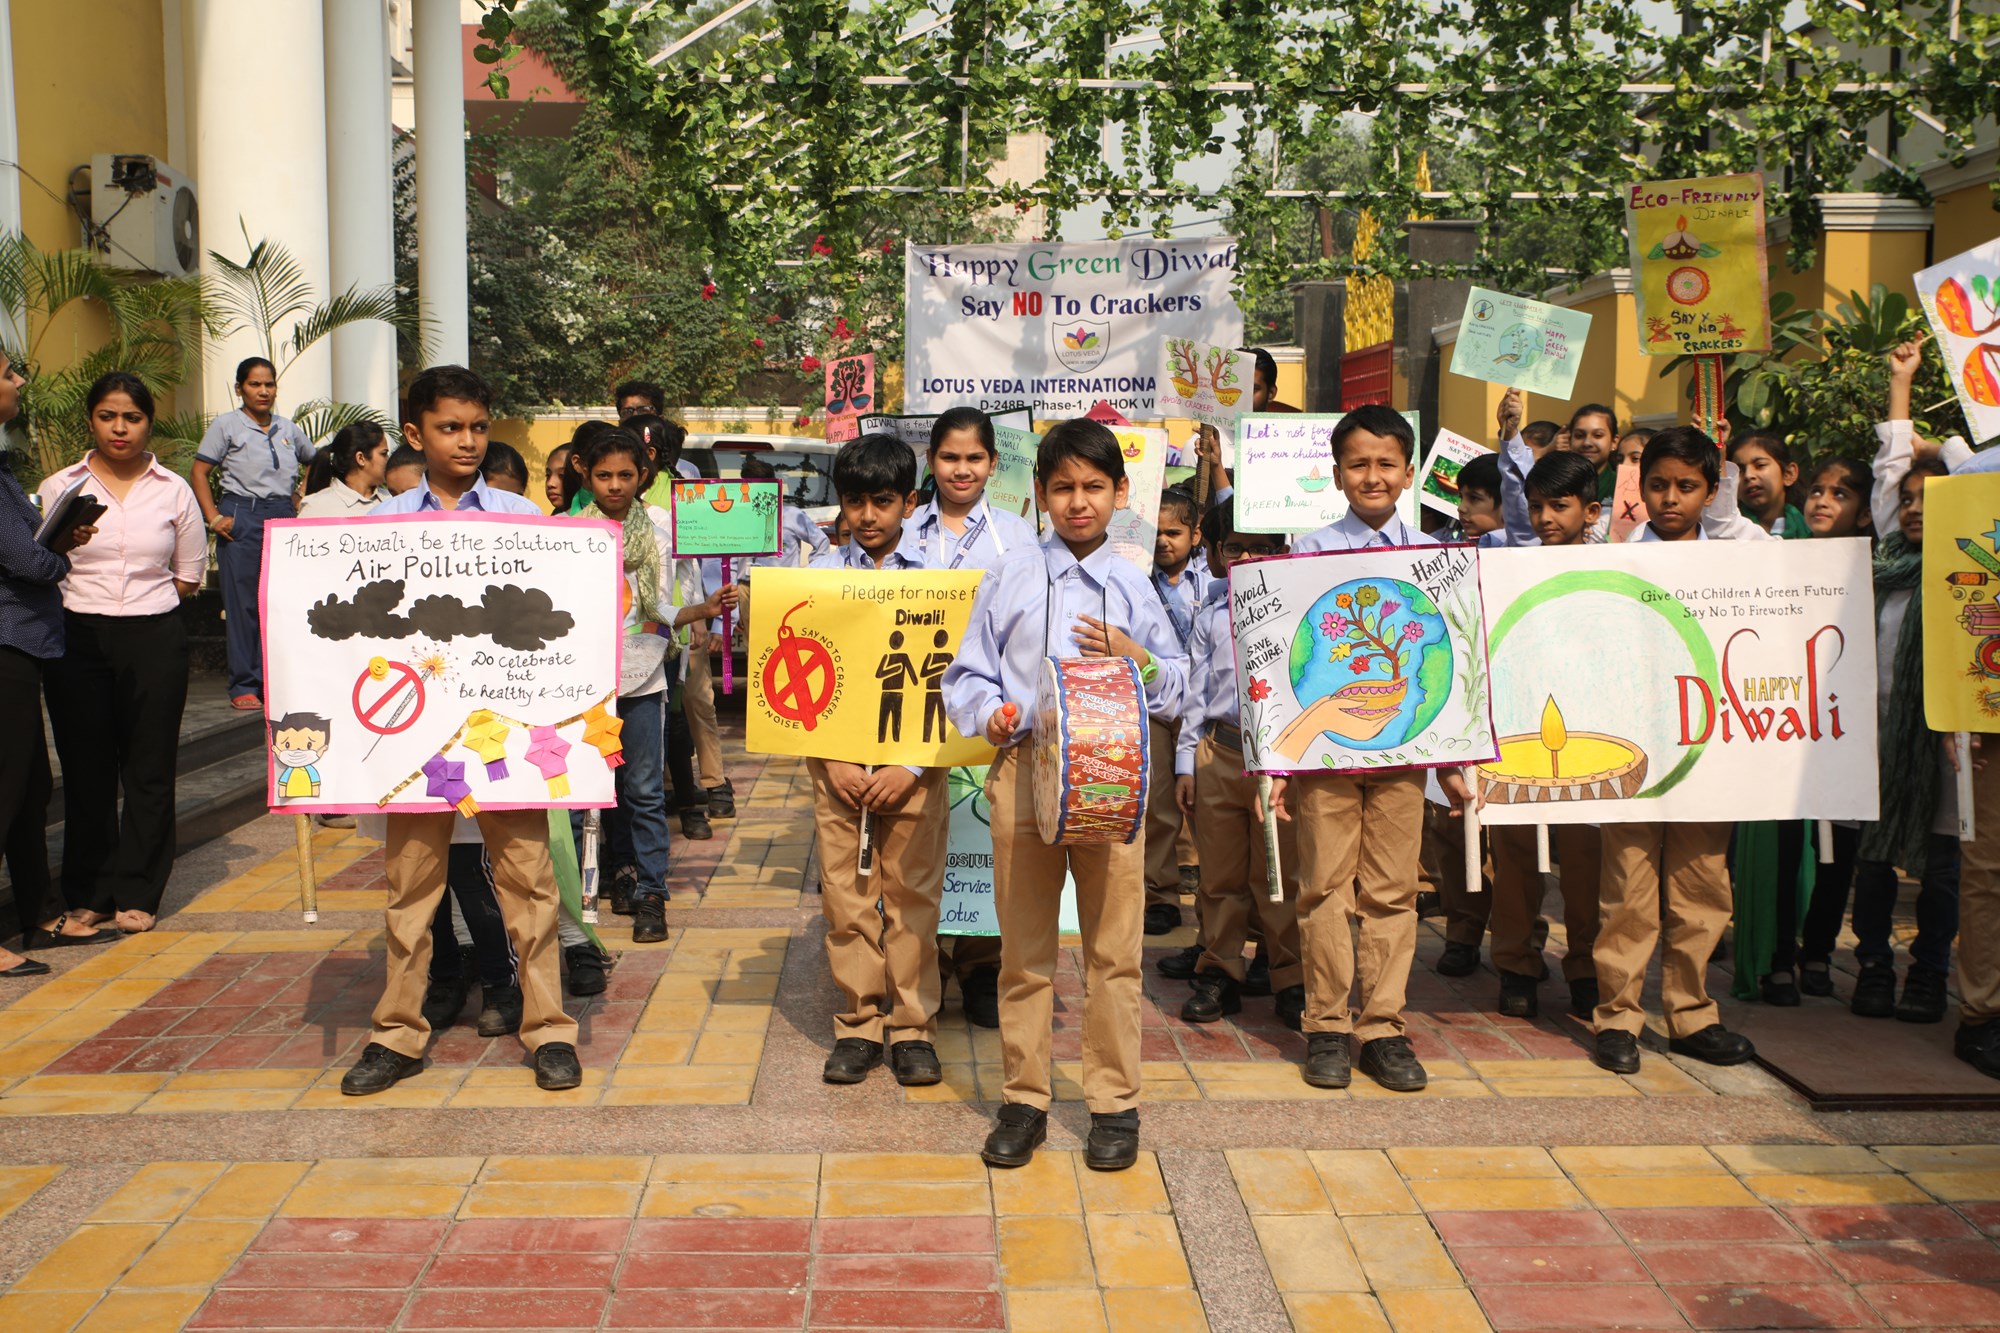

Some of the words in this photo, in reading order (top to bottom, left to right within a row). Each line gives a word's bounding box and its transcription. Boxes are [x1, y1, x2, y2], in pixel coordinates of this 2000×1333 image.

[920, 252, 1019, 287] Happy
[1028, 250, 1121, 281] Green
[962, 295, 1005, 321] Say
[1013, 291, 1042, 316] NO
[1051, 295, 1080, 316] To
[1091, 292, 1202, 315] Crackers
[1670, 310, 1696, 325] SAY
[1673, 332, 1691, 341] TO
[1683, 339, 1742, 352] CRACKERS
[922, 378, 975, 394] LOTUS
[980, 378, 1025, 394] VEDA
[1031, 376, 1157, 394] INTERNATIONA
[1033, 399, 1087, 411] Phase-1,
[1142, 398, 1154, 409] VI
[1184, 400, 1214, 413] CRACKERS
[904, 421, 910, 429] is
[1210, 416, 1235, 428] NATUR
[996, 430, 1024, 441] HAPPY
[1247, 423, 1279, 439] Let's
[1286, 422, 1306, 438] not
[1311, 423, 1333, 440] forg
[1446, 436, 1460, 446] SAY
[1448, 445, 1461, 455] SAY
[992, 491, 1018, 503] GREEN
[285, 532, 330, 558] This
[339, 531, 414, 555] Diwali,
[420, 531, 444, 552] be
[451, 530, 486, 552] the
[493, 530, 582, 554] solution
[588, 536, 607, 554] to
[346, 557, 393, 582] Air
[403, 554, 533, 580] Pollution
[1410, 548, 1455, 585] HAPPY
[841, 584, 895, 604] Pledge
[900, 585, 924, 600] for
[926, 587, 966, 601] noise
[971, 586, 978, 600] f
[1233, 570, 1269, 613] Avoid
[1641, 589, 1671, 602] Give
[1702, 587, 1751, 600] Children
[1753, 587, 1761, 598] A
[1765, 586, 1800, 599] Green
[1804, 585, 1849, 597] Future.
[895, 608, 945, 626] Diwali!
[1231, 597, 1283, 640] Crackers
[1683, 606, 1705, 619] Say
[1709, 606, 1727, 617] No
[1730, 605, 1745, 617] To
[1749, 604, 1803, 616] Fireworks
[800, 627, 820, 639] SAY
[820, 635, 834, 649] NO
[1246, 636, 1273, 658] SAVE
[471, 651, 494, 667] Do
[757, 646, 774, 669] SAY
[833, 648, 842, 663] TO
[507, 669, 536, 681] but
[752, 670, 760, 689] NO
[821, 666, 845, 721] CRACKERS
[1674, 624, 1845, 746] Diwali
[1743, 675, 1803, 702] HAPPY
[459, 683, 477, 700] be
[480, 684, 534, 707] healthy
[755, 693, 766, 708] TO
[764, 709, 800, 730] NOISE
[946, 852, 994, 868] OSIVE
[942, 872, 992, 894] Service
